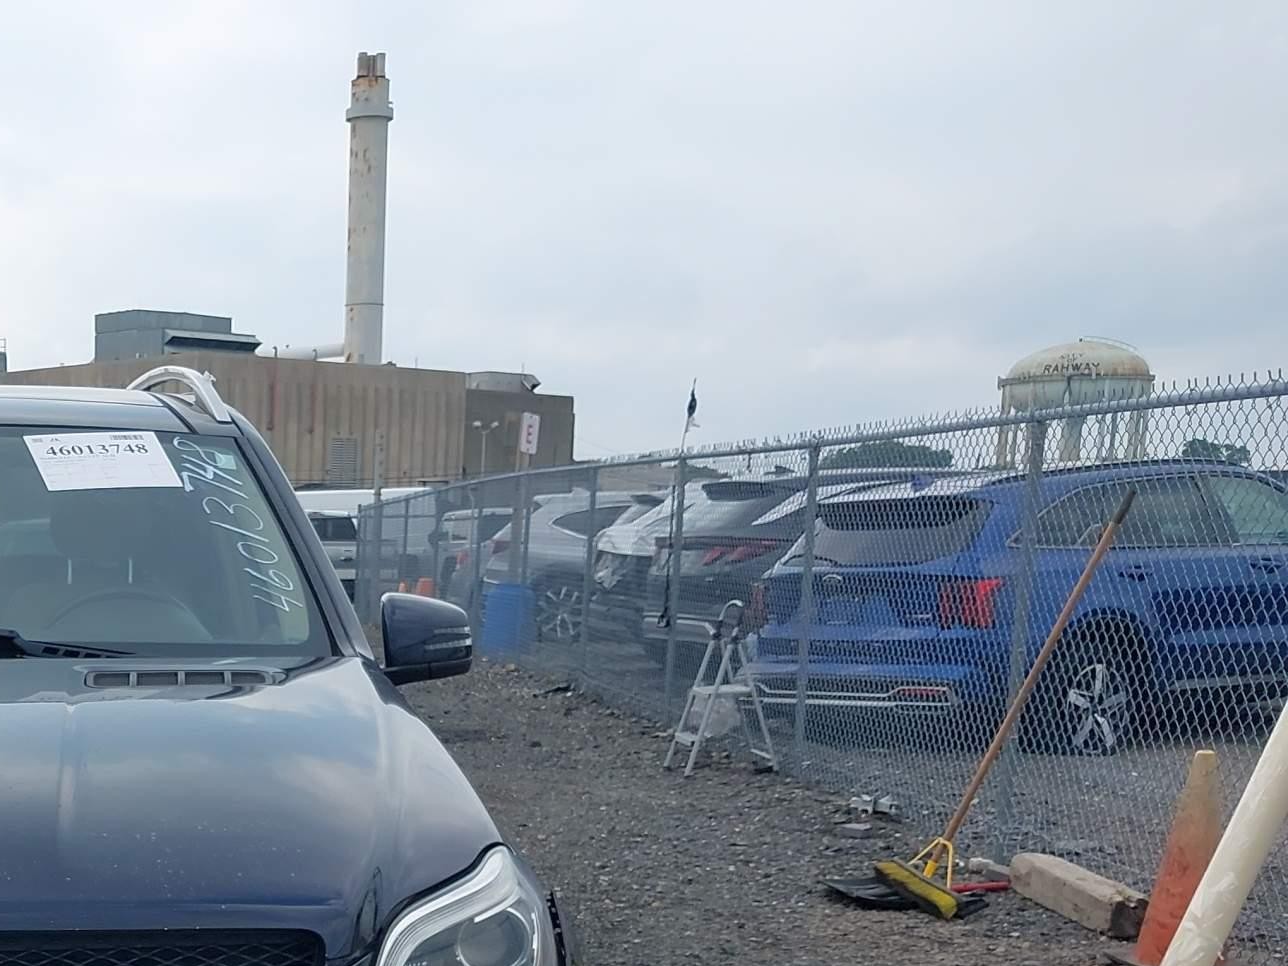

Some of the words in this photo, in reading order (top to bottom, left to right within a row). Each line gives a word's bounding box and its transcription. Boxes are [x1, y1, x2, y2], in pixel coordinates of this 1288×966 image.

[1043, 362, 1100, 374] RAHWAY
[525, 424, 534, 445] E
[46, 443, 149, 457] 46013748
